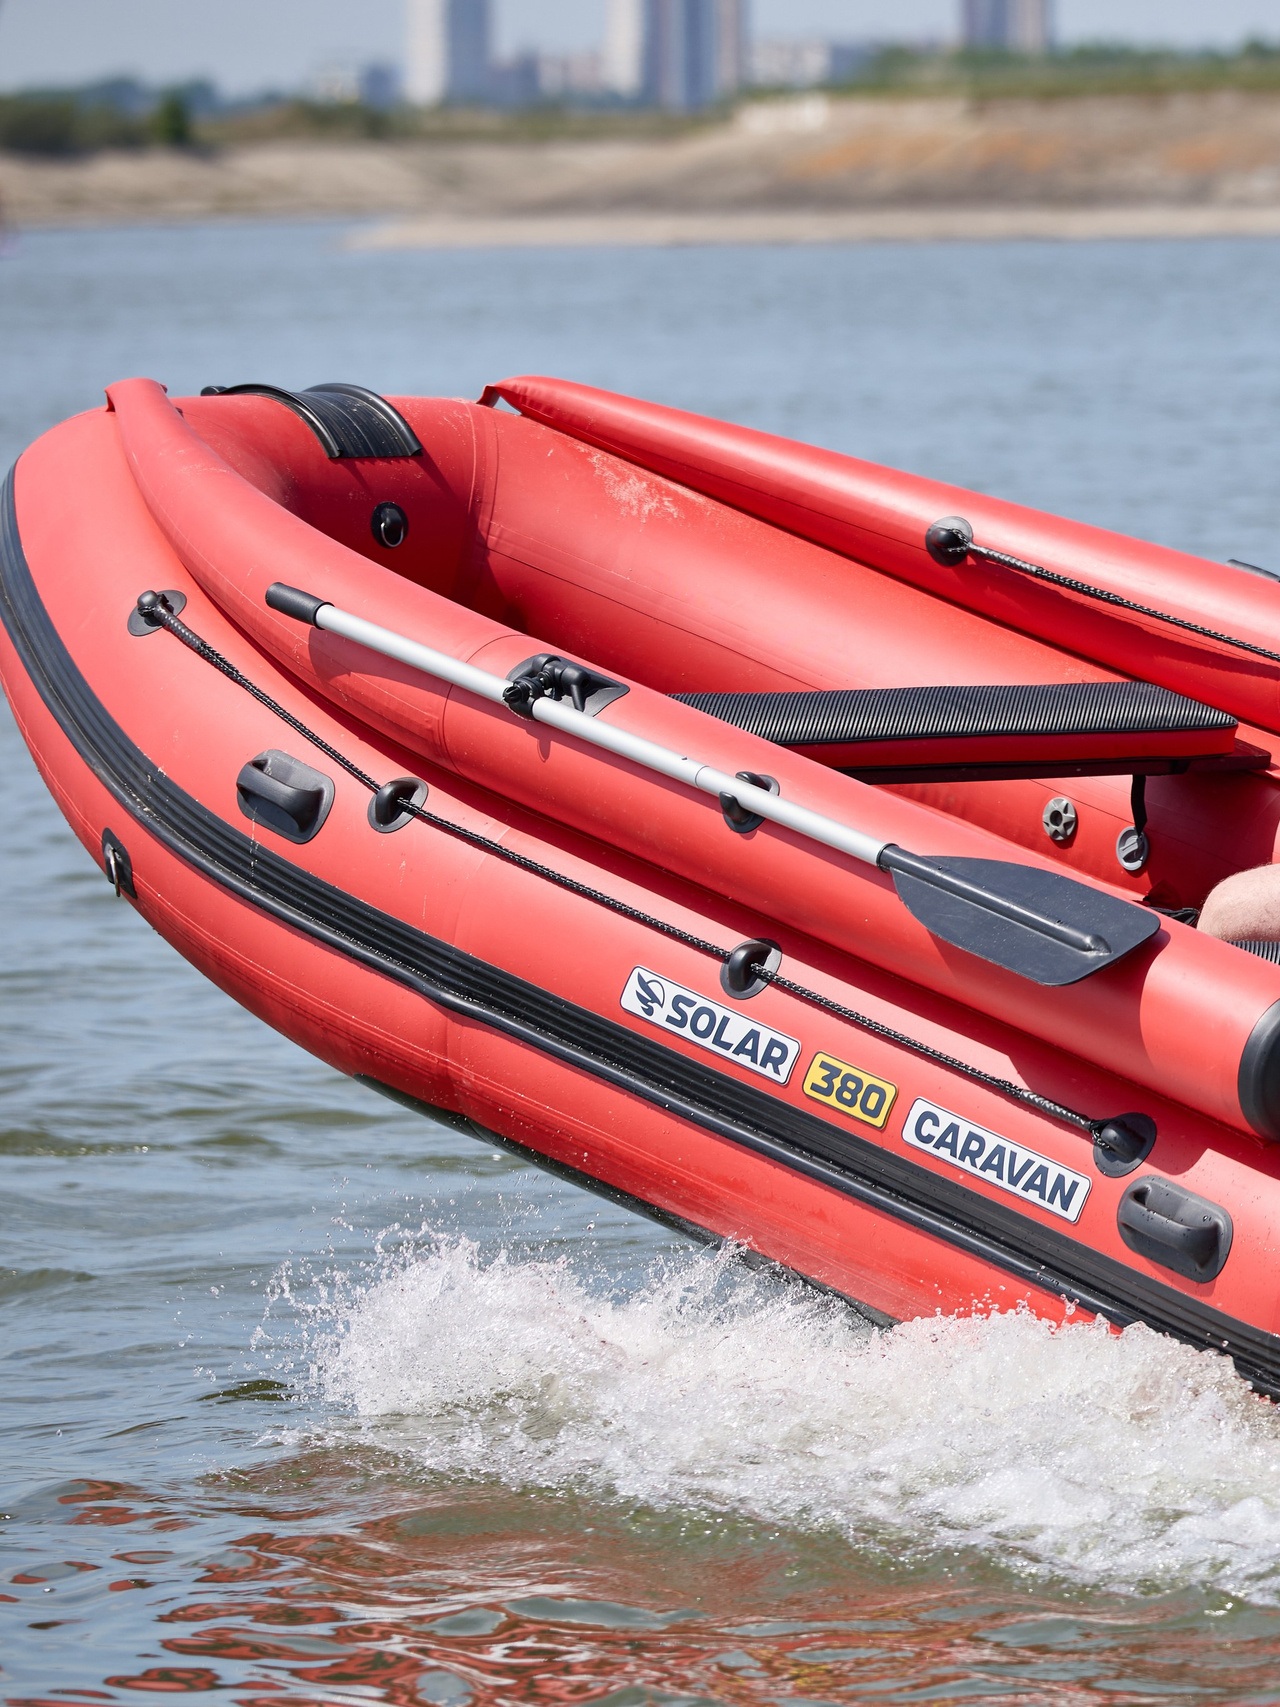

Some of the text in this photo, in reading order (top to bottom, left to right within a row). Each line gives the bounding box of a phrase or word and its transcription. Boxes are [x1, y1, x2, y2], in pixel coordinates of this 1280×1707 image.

[665, 994, 1080, 1212] SOLAR 380 CARAVAN
